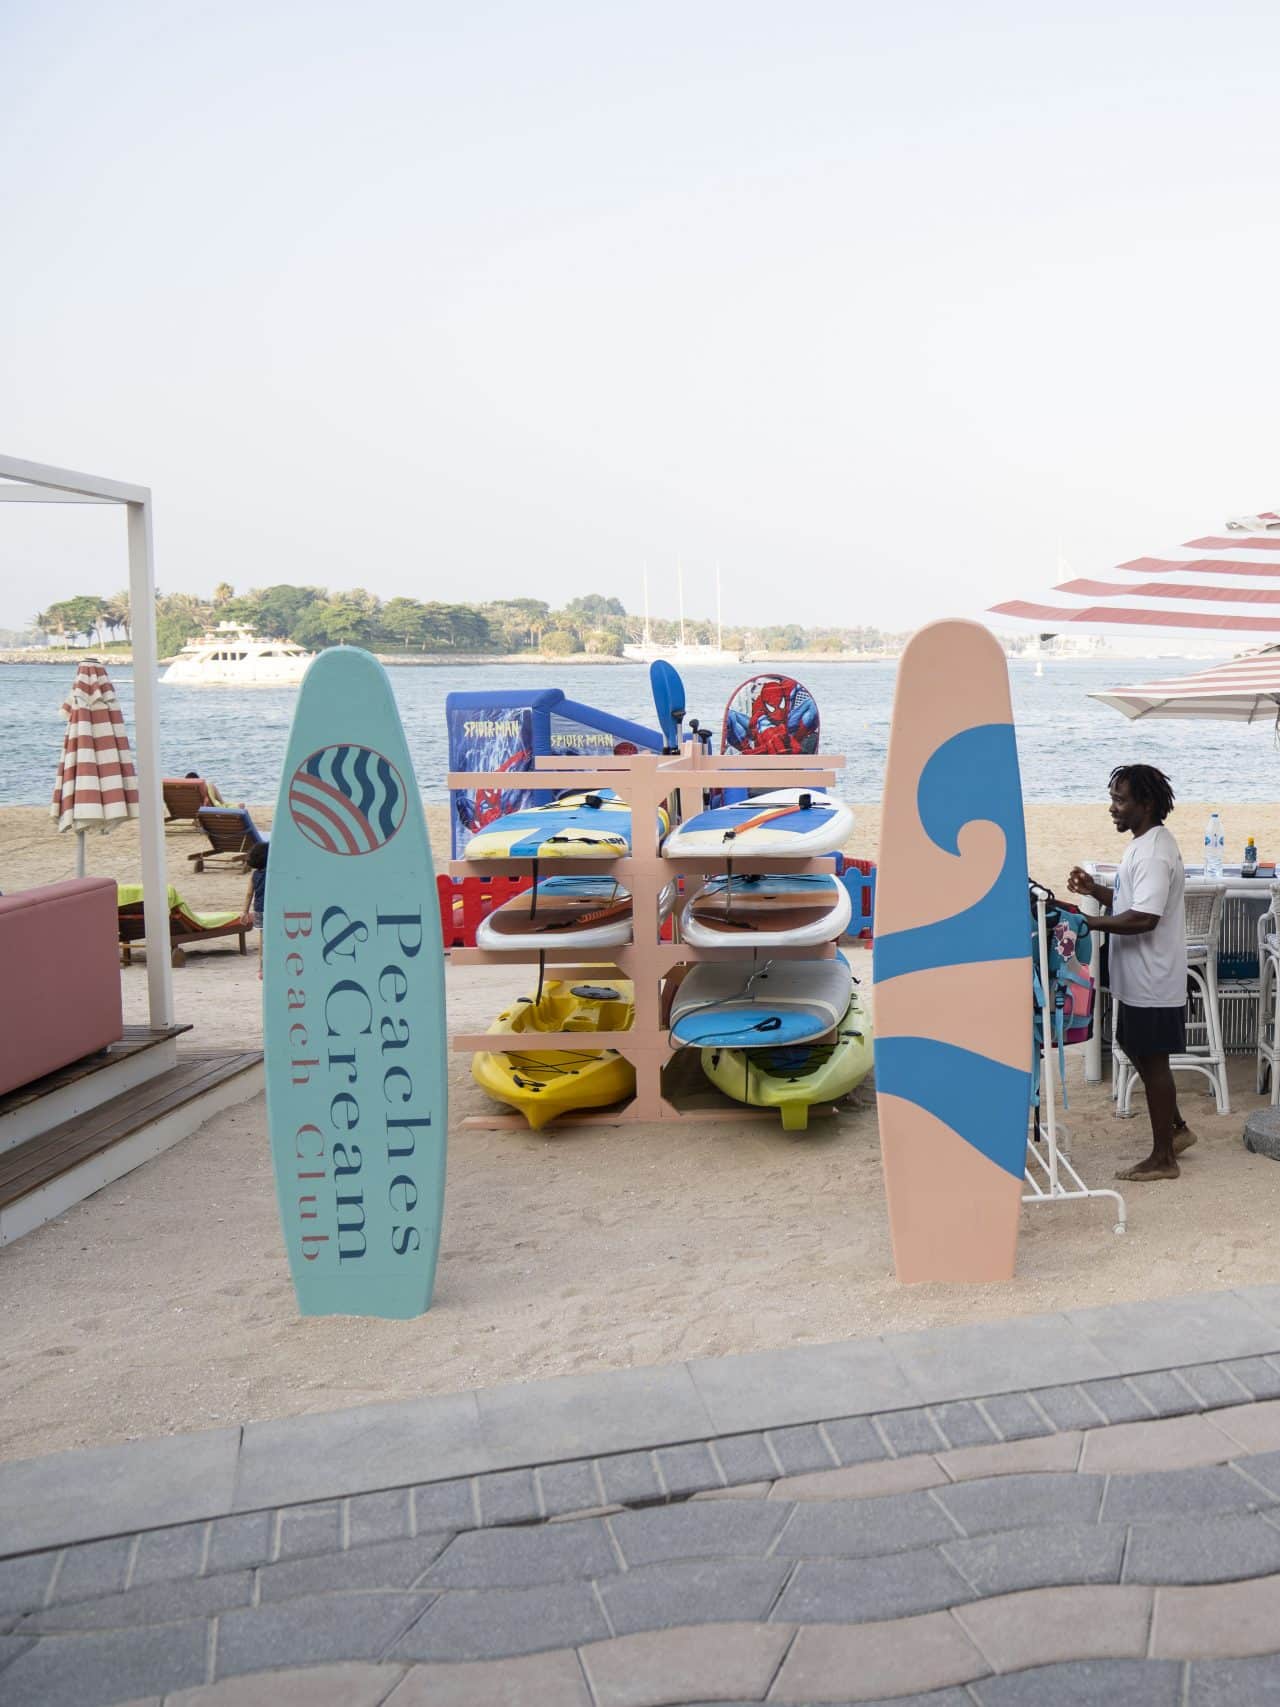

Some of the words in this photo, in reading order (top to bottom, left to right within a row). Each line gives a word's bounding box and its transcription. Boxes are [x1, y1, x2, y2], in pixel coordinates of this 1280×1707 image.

[463, 720, 520, 738] SPIDER-MAN
[282, 905, 321, 1087] Beach
[375, 903, 432, 1257] Peaches
[294, 1122, 331, 1263] Club
